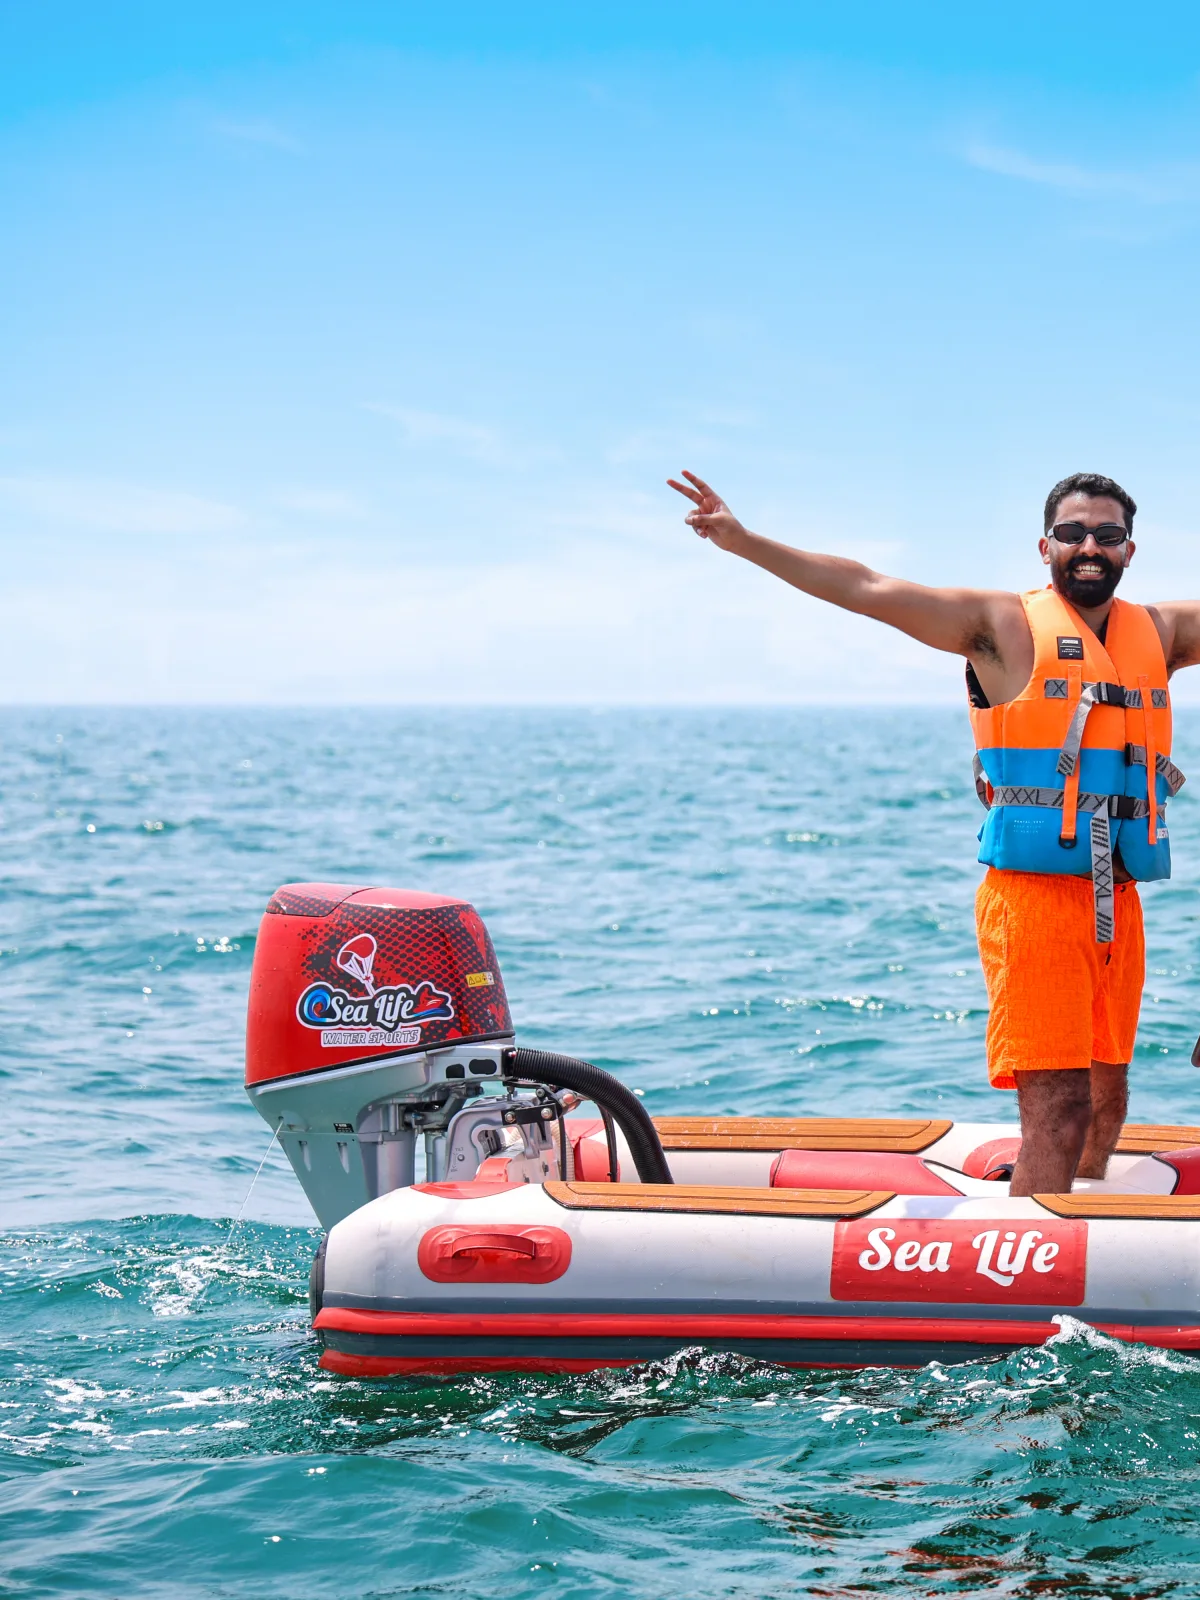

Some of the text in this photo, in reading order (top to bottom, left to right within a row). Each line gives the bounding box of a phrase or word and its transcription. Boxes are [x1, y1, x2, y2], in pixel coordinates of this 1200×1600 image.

[1094, 852, 1111, 908] XXXL
[327, 992, 414, 1029] Sea Life
[323, 1029, 419, 1045] WATER SPORTS
[858, 1227, 1060, 1287] Sea Life
